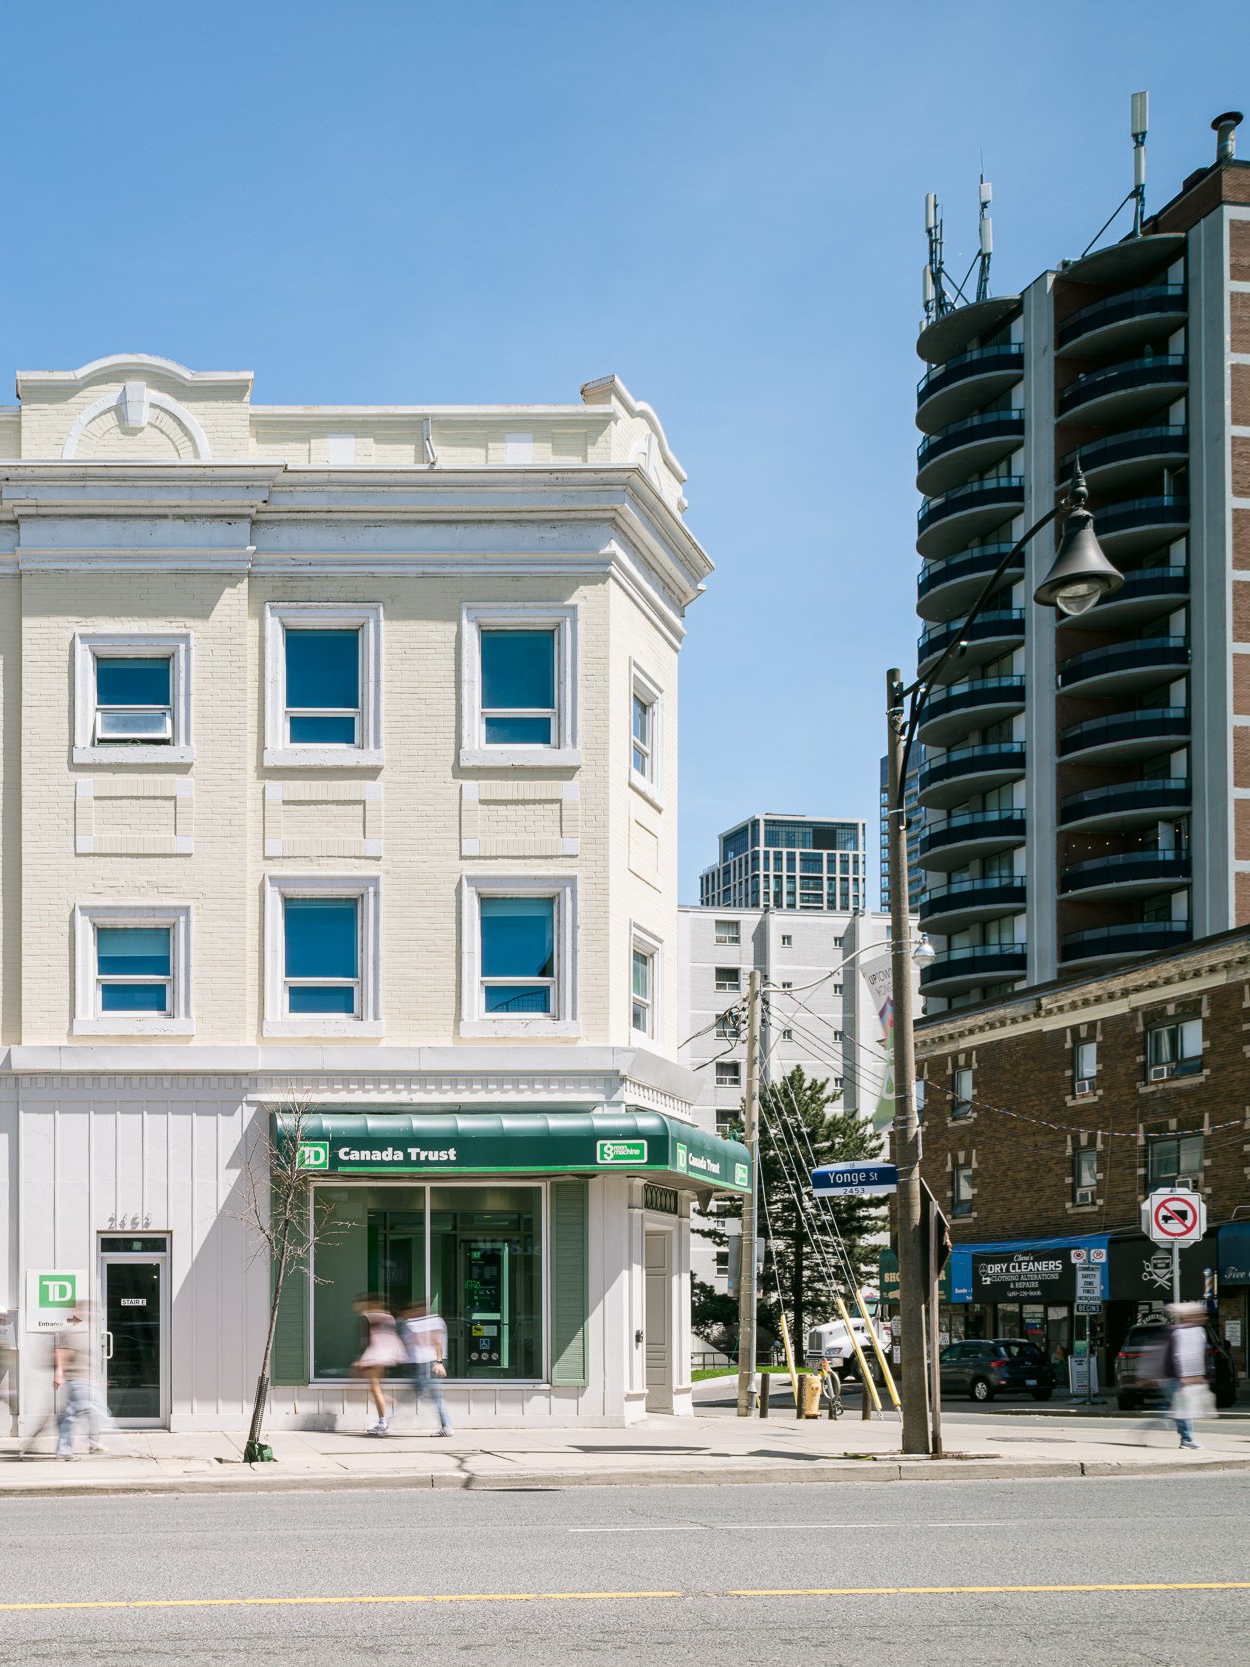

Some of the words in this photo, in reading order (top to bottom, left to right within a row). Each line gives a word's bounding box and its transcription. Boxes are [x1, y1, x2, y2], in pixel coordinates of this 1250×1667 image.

[298, 1146, 325, 1165] TD
[338, 1147, 404, 1161] Canada
[407, 1147, 457, 1161] Trust
[689, 1152, 707, 1171] Canada
[706, 1158, 720, 1175] Trust
[828, 1172, 866, 1184] Yonge
[869, 1172, 878, 1181] St
[843, 1187, 866, 1195] 2453
[987, 1263, 1008, 1274] DRY
[1009, 1260, 1063, 1273] CLEANERS
[1020, 1273, 1059, 1281] ALTERATIONS
[42, 1281, 73, 1302] TD
